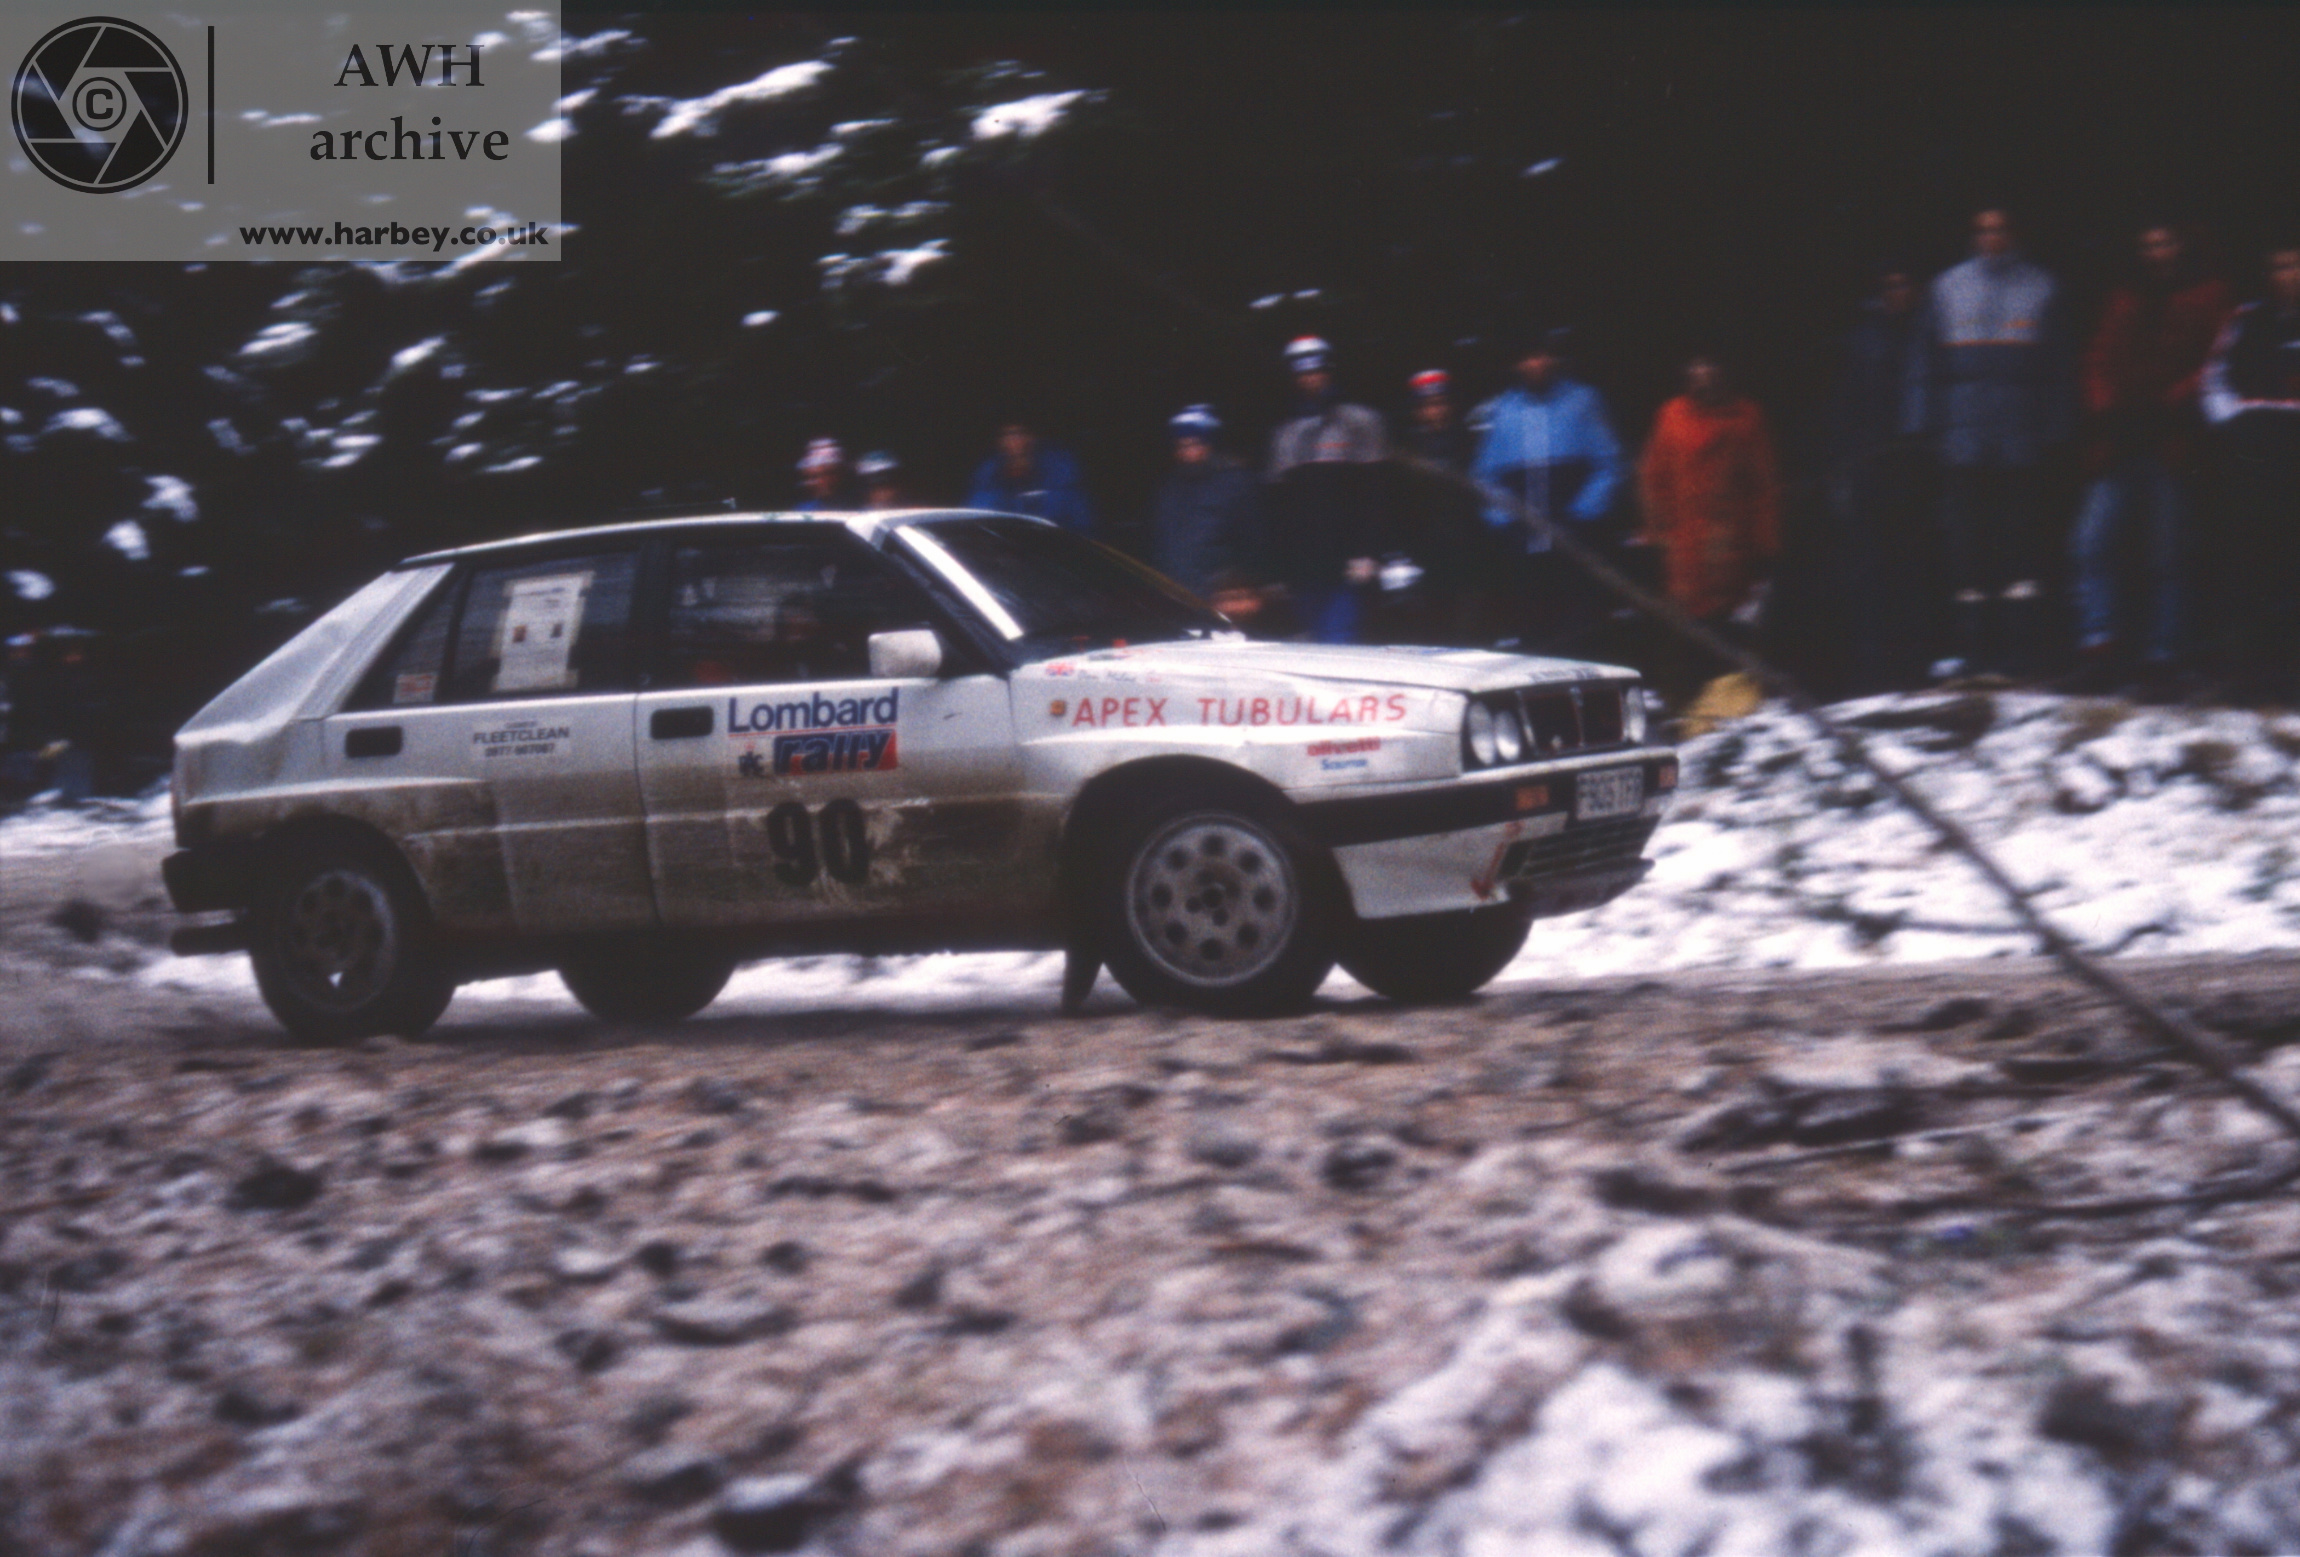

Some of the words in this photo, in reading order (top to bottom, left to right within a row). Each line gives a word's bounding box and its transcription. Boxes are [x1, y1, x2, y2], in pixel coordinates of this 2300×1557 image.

[727, 686, 900, 734] Lombard
[1071, 696, 1169, 728] APEX
[1197, 693, 1408, 728] TUBULARS
[473, 726, 570, 745] FLEETCLEAN
[777, 730, 896, 774] rally
[766, 798, 870, 887] 90
